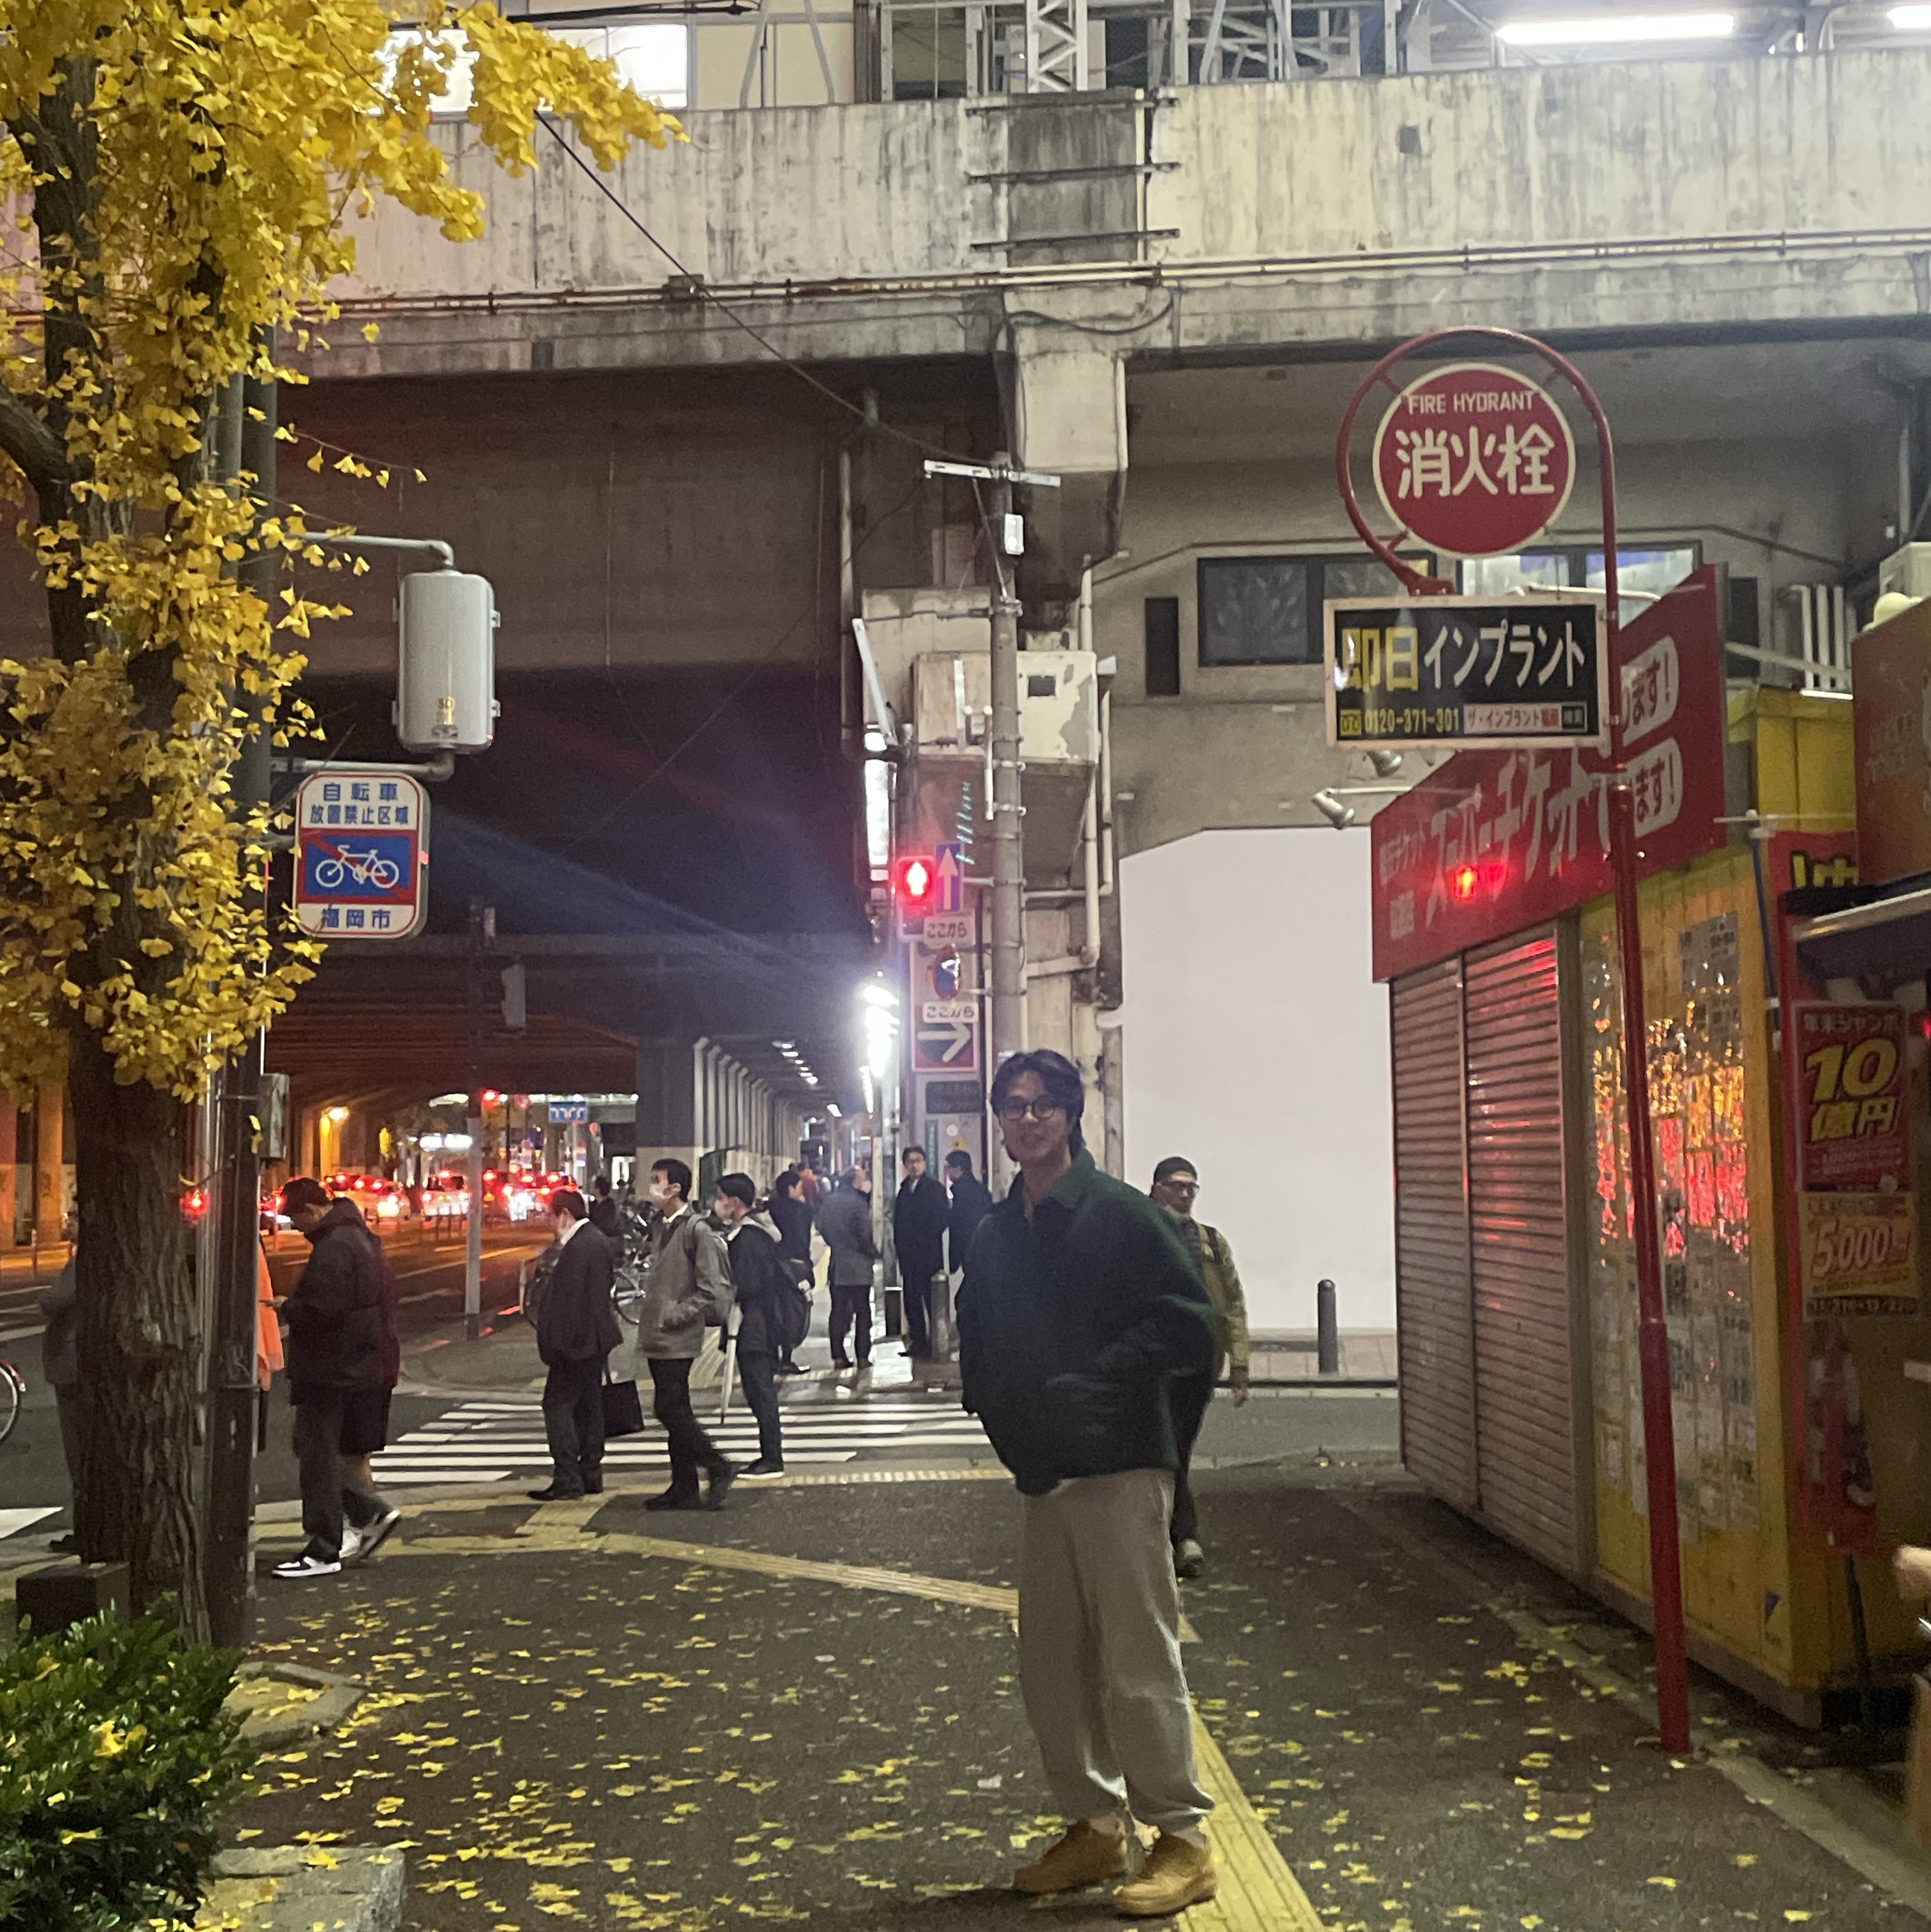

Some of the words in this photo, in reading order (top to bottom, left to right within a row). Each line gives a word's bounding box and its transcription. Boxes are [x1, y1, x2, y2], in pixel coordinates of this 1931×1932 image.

[1408, 393, 1446, 415] FIRE
[1453, 390, 1534, 413] HYDRANT
[1396, 423, 1555, 499] 消火栓
[1364, 707, 1460, 734] 0120-371-301
[323, 782, 398, 802] 自転車
[310, 804, 409, 825] 放置禁止区域
[322, 908, 391, 929] 福岡市
[927, 922, 967, 938] ここから
[926, 1005, 975, 1019] ここから
[1806, 1038, 1897, 1103] 10
